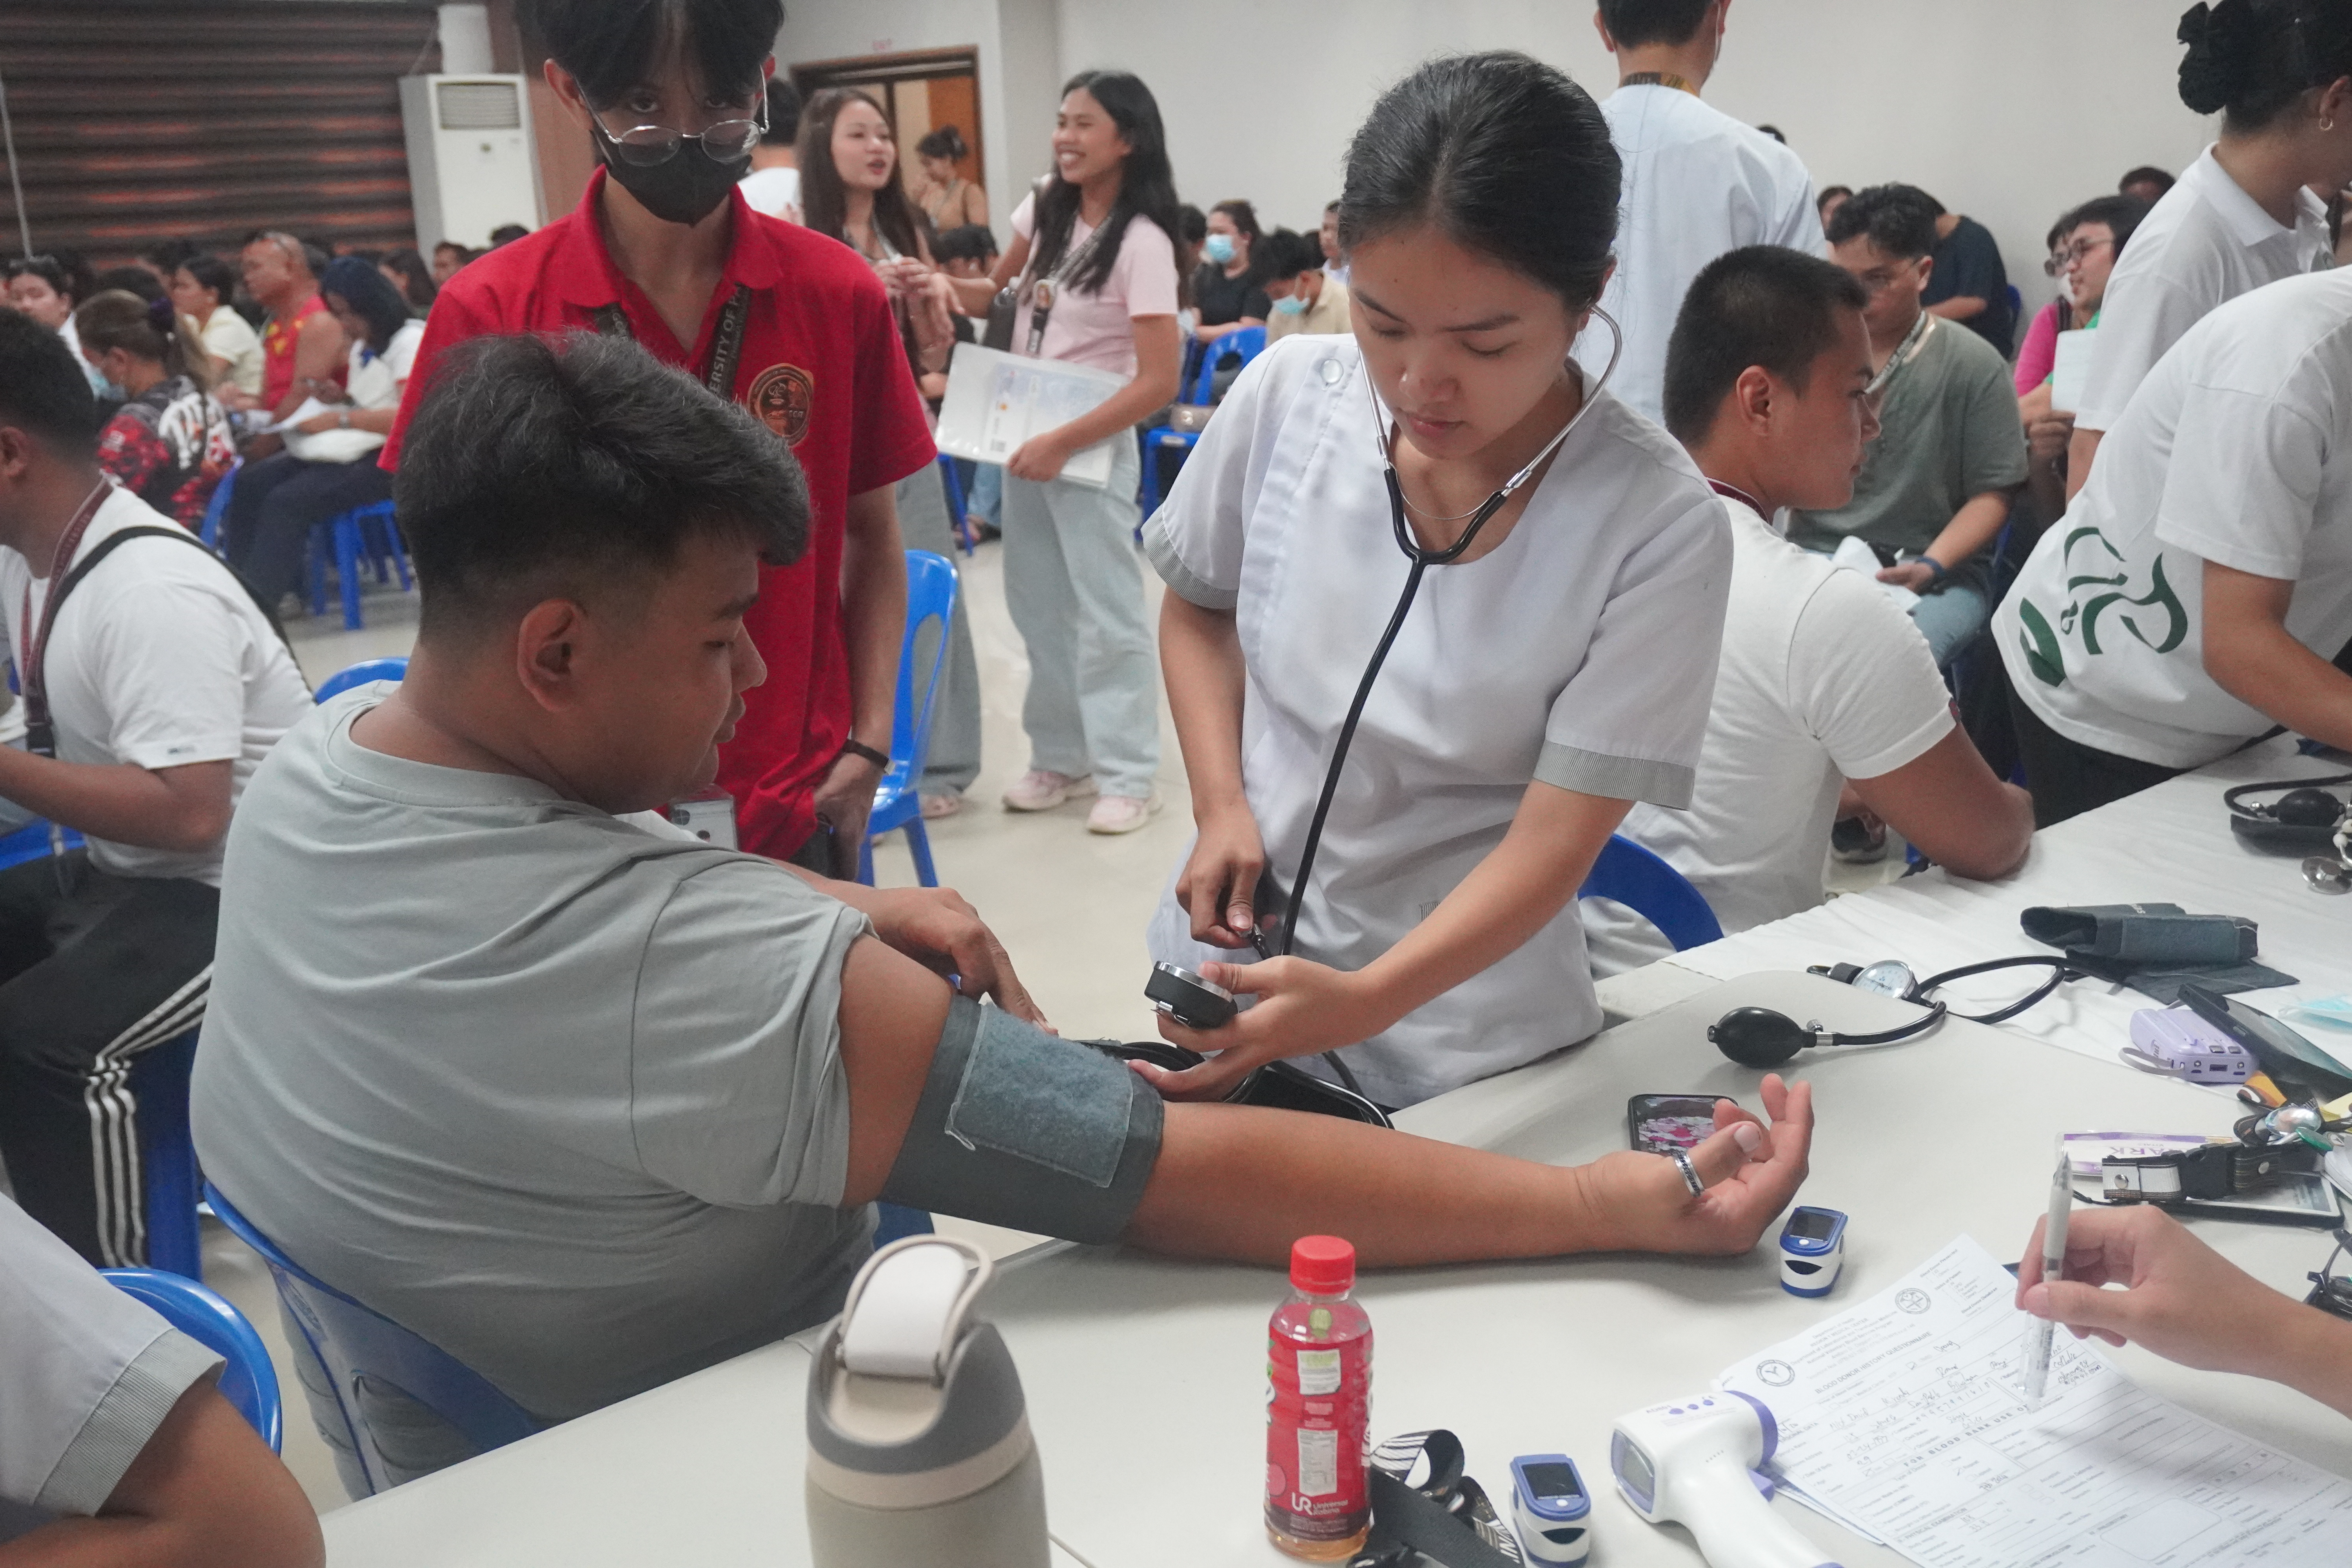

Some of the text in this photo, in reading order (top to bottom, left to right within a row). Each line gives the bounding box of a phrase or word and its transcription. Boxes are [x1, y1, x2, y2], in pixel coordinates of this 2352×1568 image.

[708, 309, 735, 393] ERSITY OF
[1878, 1311, 1897, 1321] Medicine
[1807, 1353, 1825, 1363] National
[1815, 1332, 1931, 1394] BLOOD DONOR HISTORY QUESTIONNAIRE
[1929, 1437, 1960, 1454] BLOOD
[1966, 1423, 1991, 1436] BANK
[1994, 1412, 2013, 1423] USE
